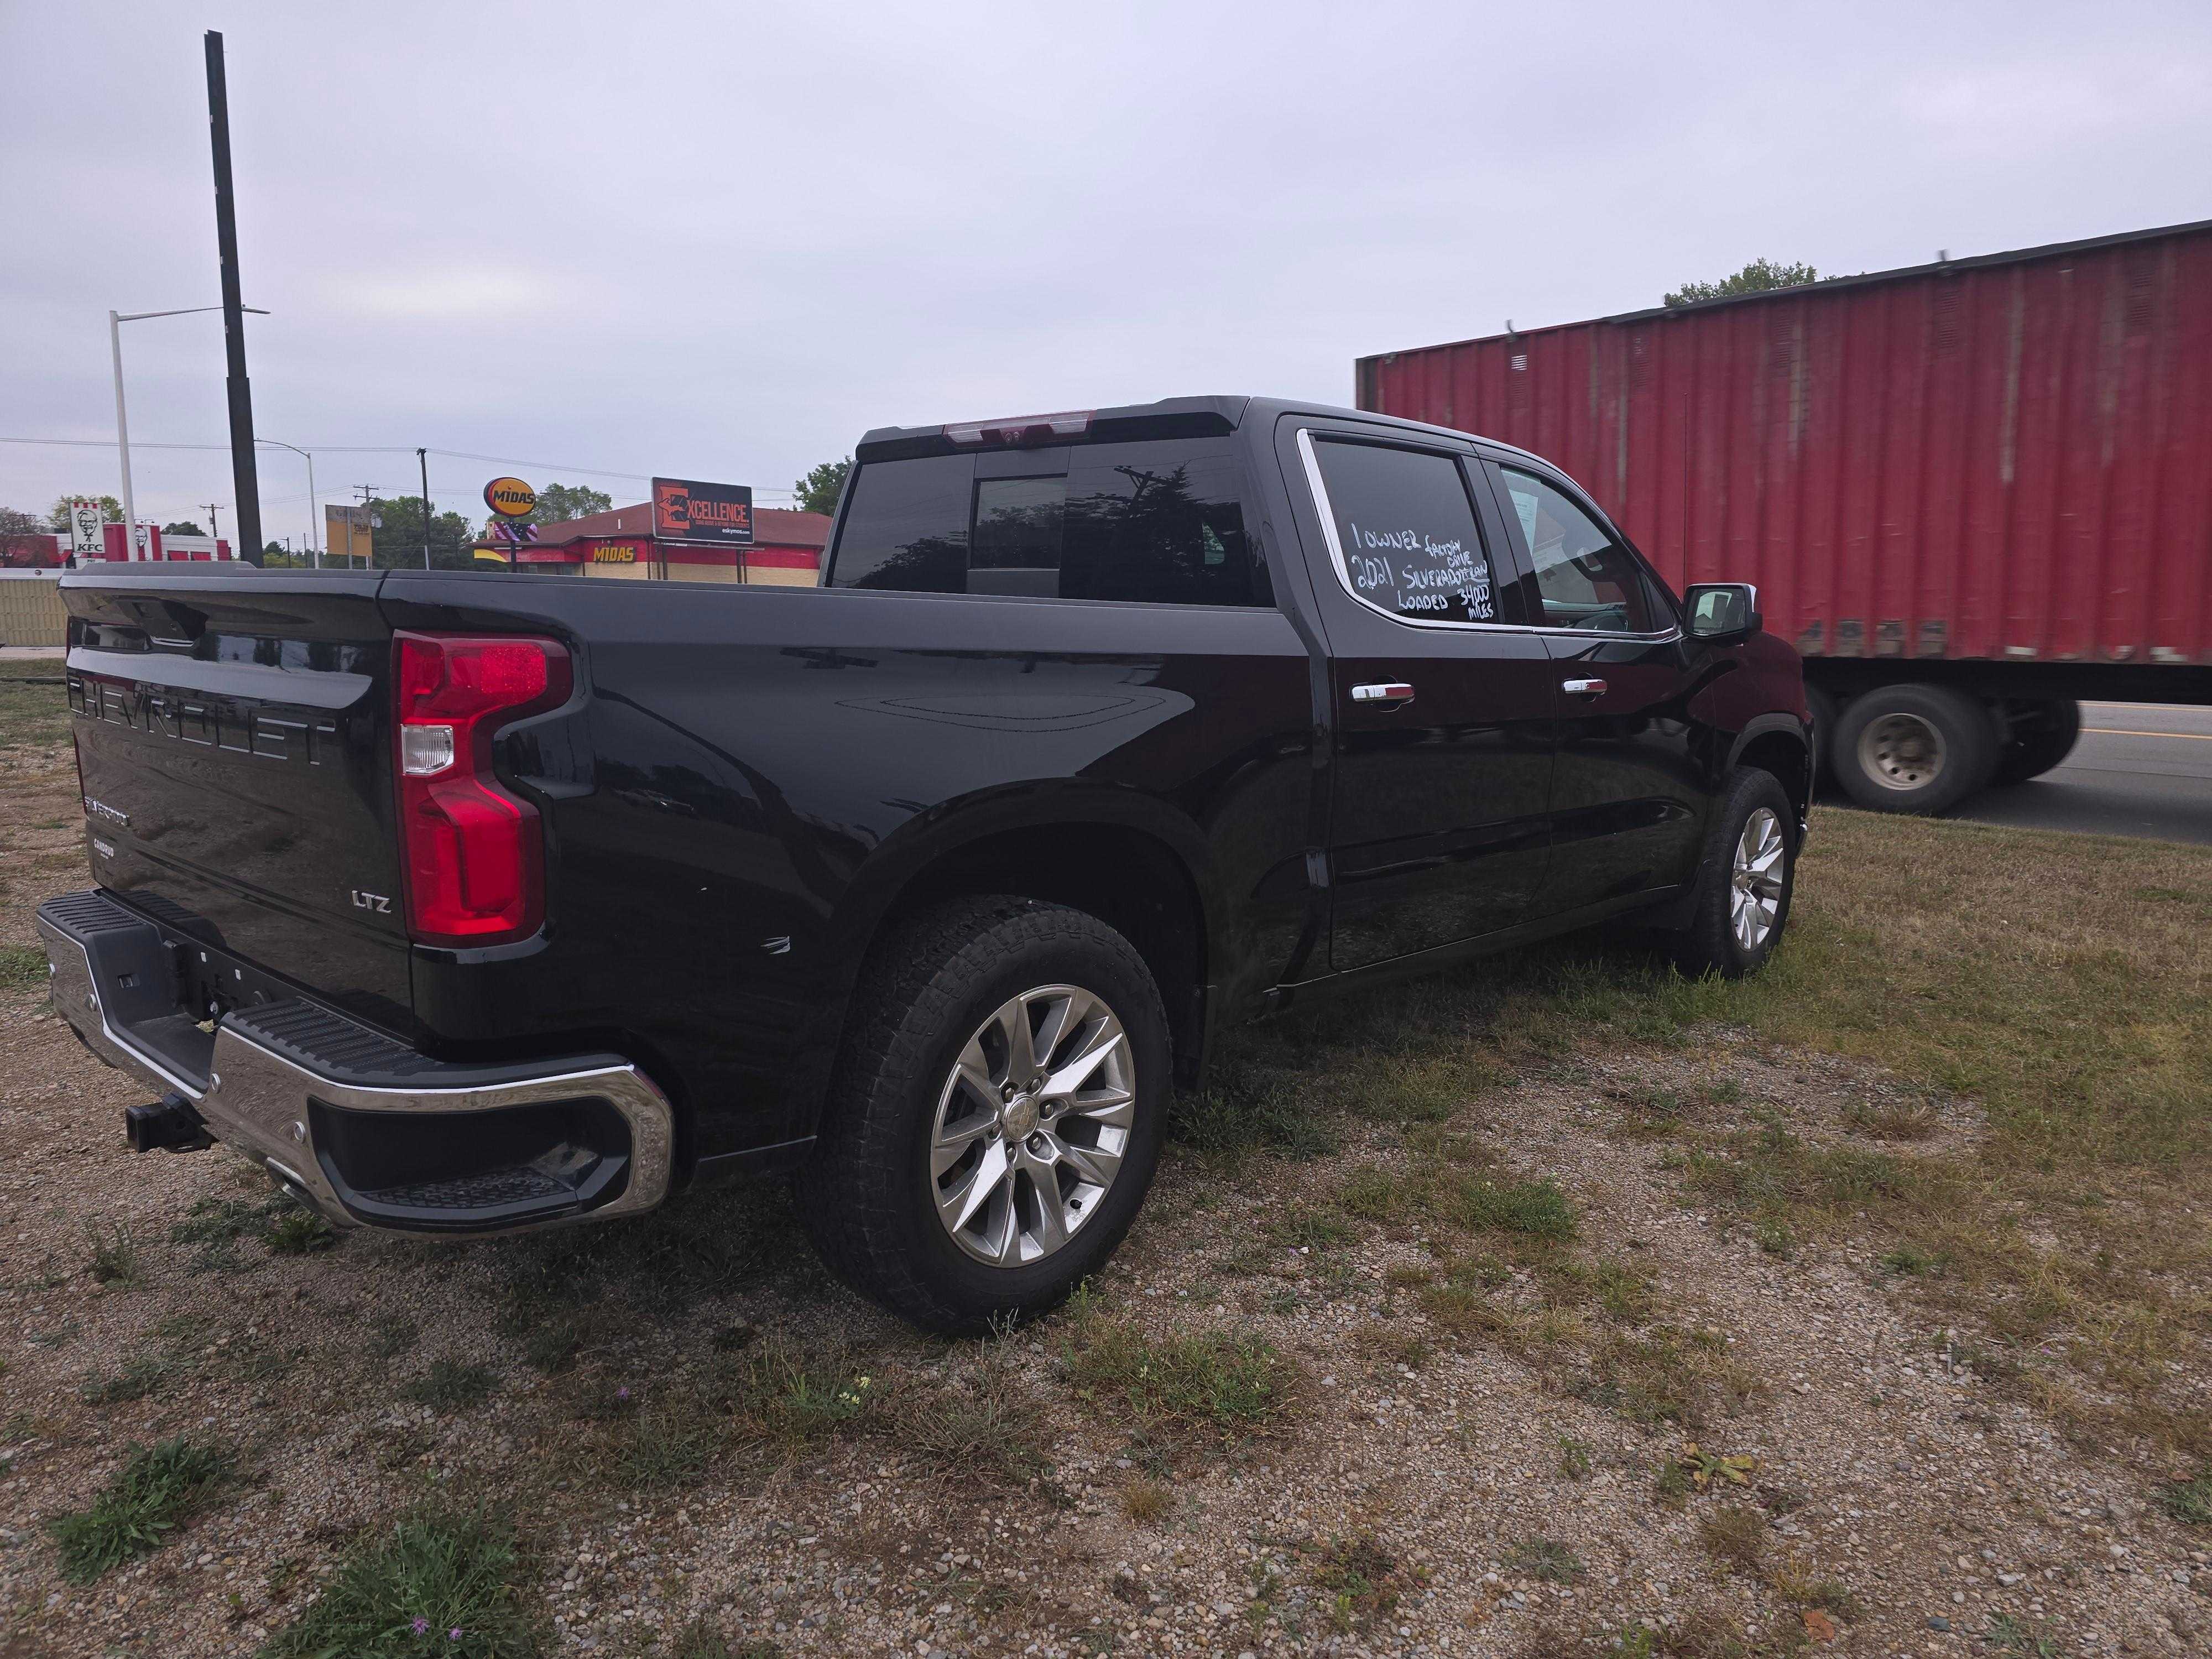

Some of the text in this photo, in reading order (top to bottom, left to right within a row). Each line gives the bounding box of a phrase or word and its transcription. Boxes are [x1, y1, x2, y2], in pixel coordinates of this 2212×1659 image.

[493, 488, 535, 504] MIDAS
[76, 544, 103, 552] KFC
[1365, 529, 1422, 551] OWNER
[593, 547, 634, 562] MIDAS
[1351, 555, 1462, 589] 2021 SILVERADO
[1397, 590, 1448, 611] LOADED
[1468, 602, 1494, 620] MILES
[67, 678, 335, 766] CHEVROLET
[352, 890, 392, 914] LTZ
